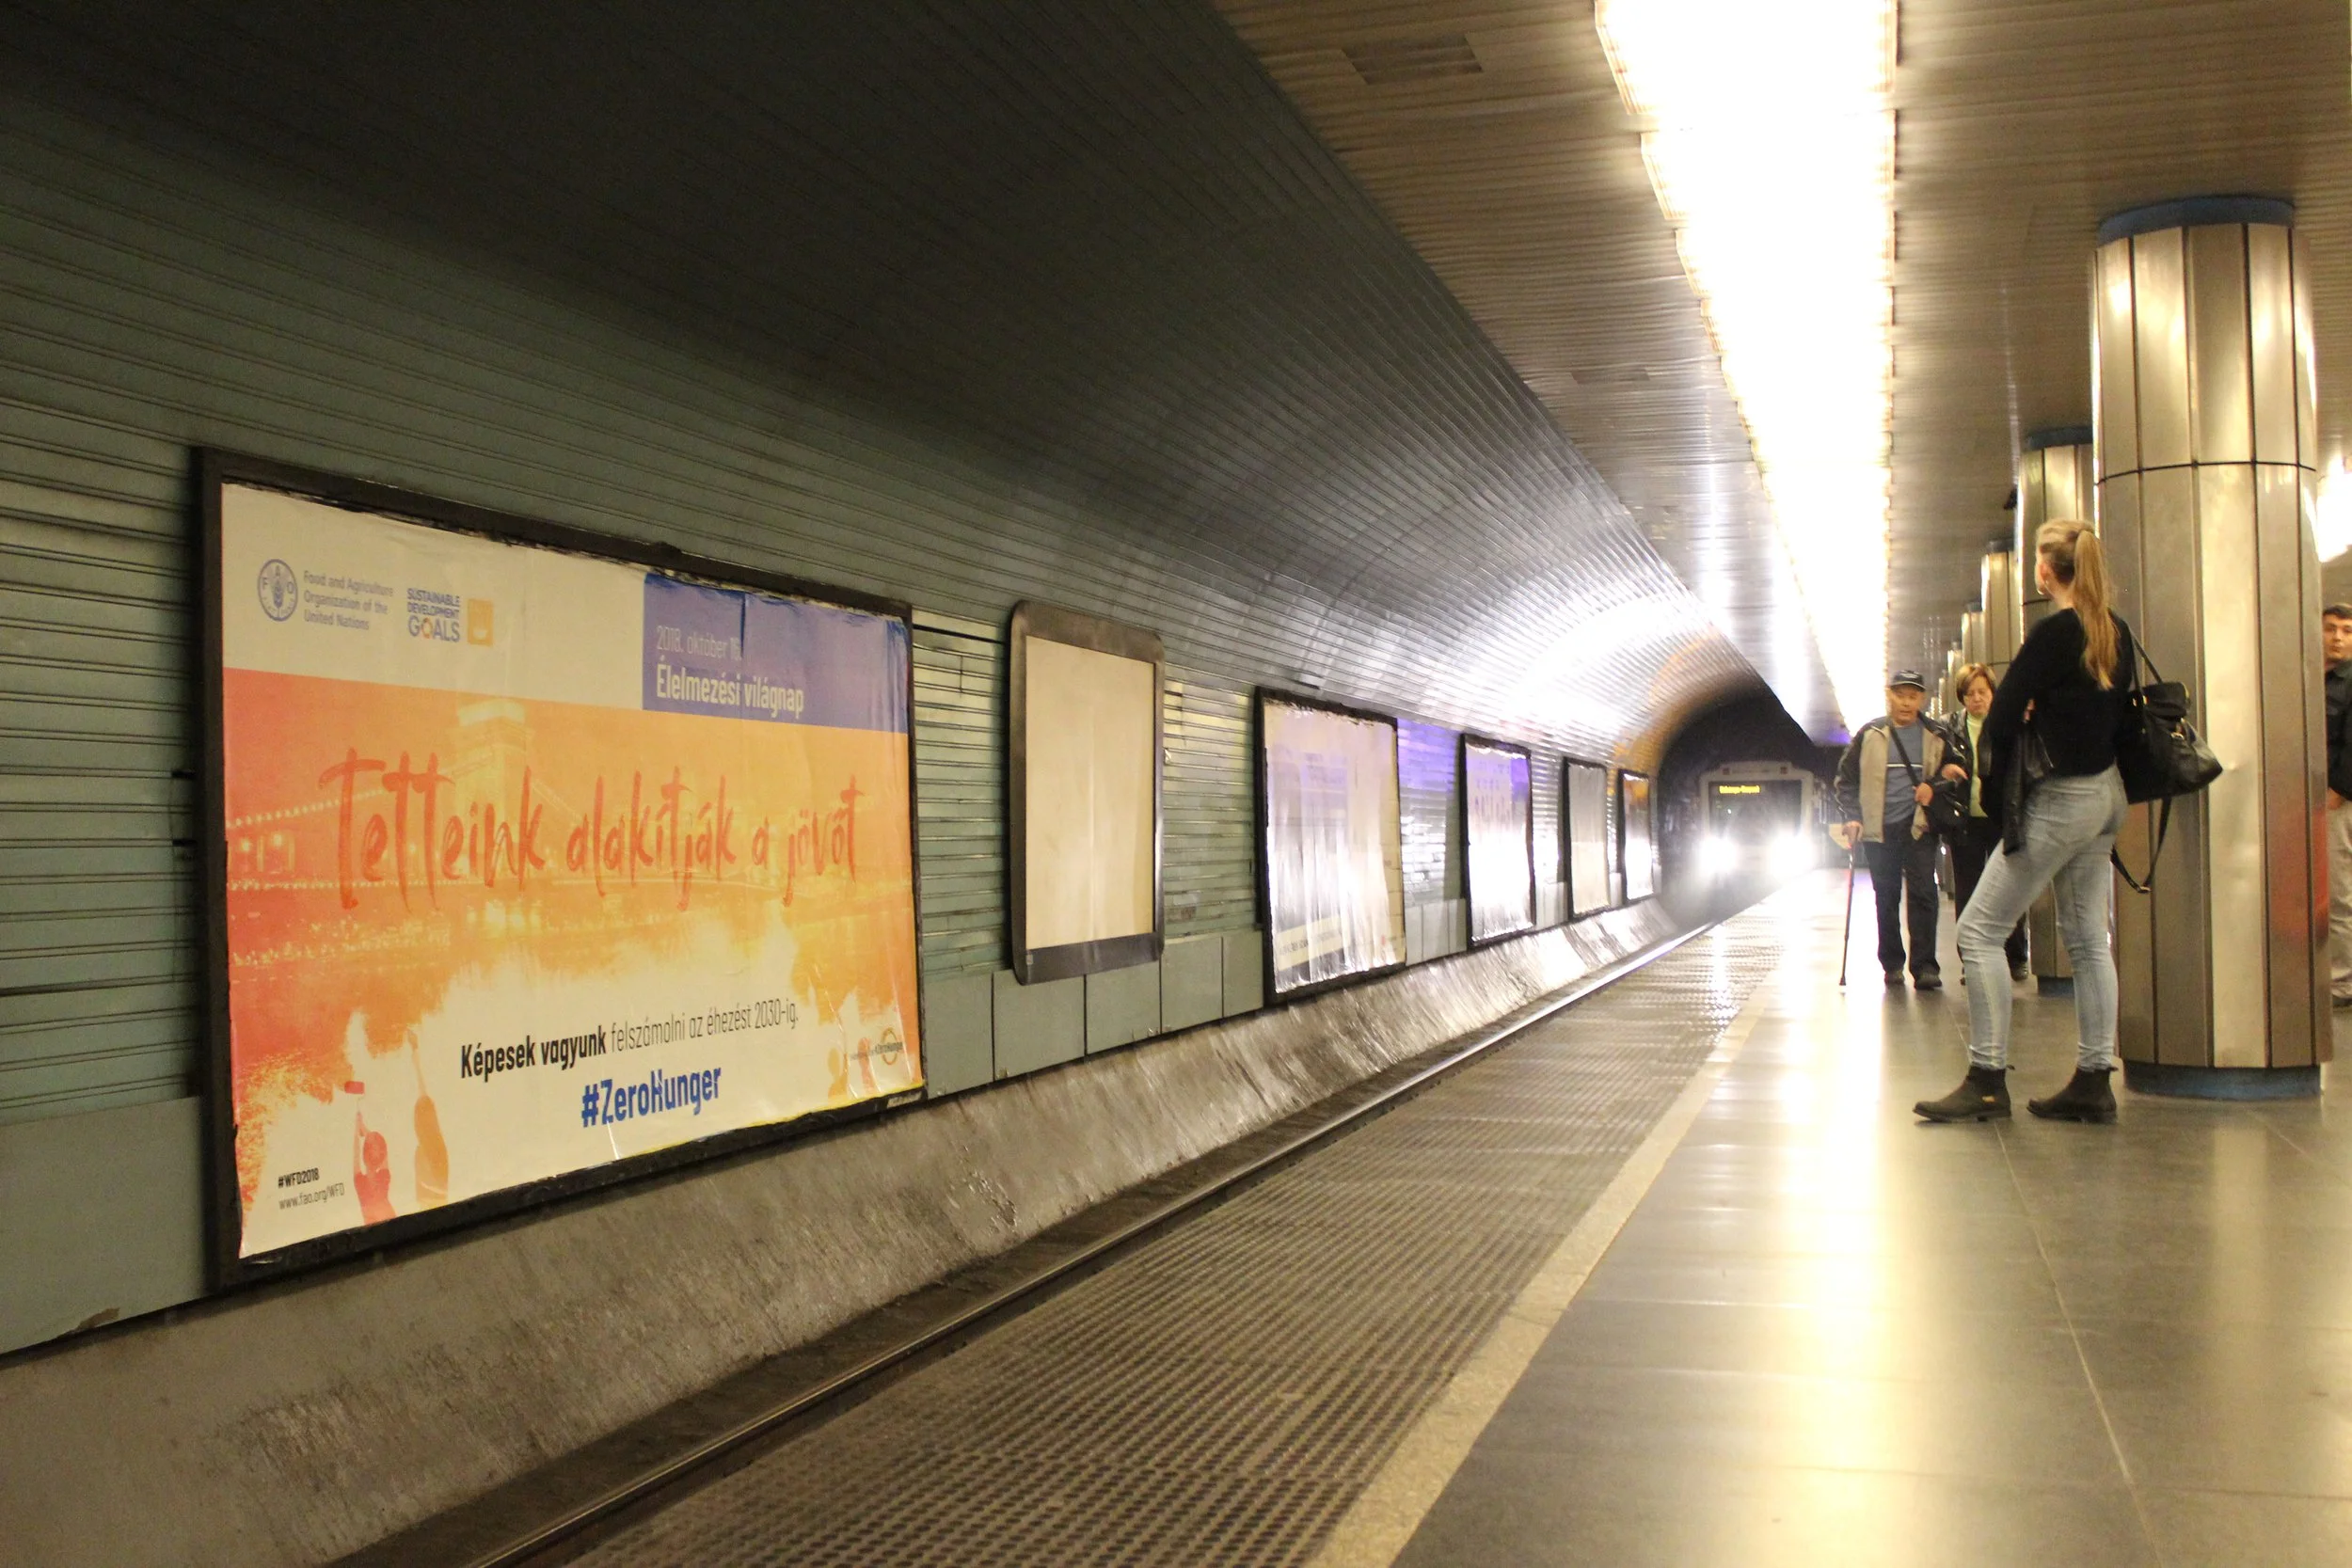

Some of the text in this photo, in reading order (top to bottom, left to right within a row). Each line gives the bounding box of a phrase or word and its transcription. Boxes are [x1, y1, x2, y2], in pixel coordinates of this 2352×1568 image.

[304, 570, 393, 597] Food and Agriculture
[304, 590, 360, 610] Organization
[362, 598, 373, 611] of
[374, 601, 388, 614] the
[406, 588, 460, 608] SUSTAINABLE
[406, 602, 459, 619] DEVELOPMENT
[304, 610, 369, 629] United Nations
[408, 615, 460, 643] GOALS
[657, 625, 684, 653] 2018.
[657, 655, 803, 720] Élelmezési világnap
[318, 748, 866, 916] Tetteink alakítják a jövőt
[461, 998, 800, 1083] Képesek vagyunk felszámolni az éhezést 2030-ig.
[580, 1067, 722, 1128] #ZeroHunger
[278, 1167, 320, 1188] #WFD2018
[278, 1182, 345, 1210] www.fao.org/WFD
